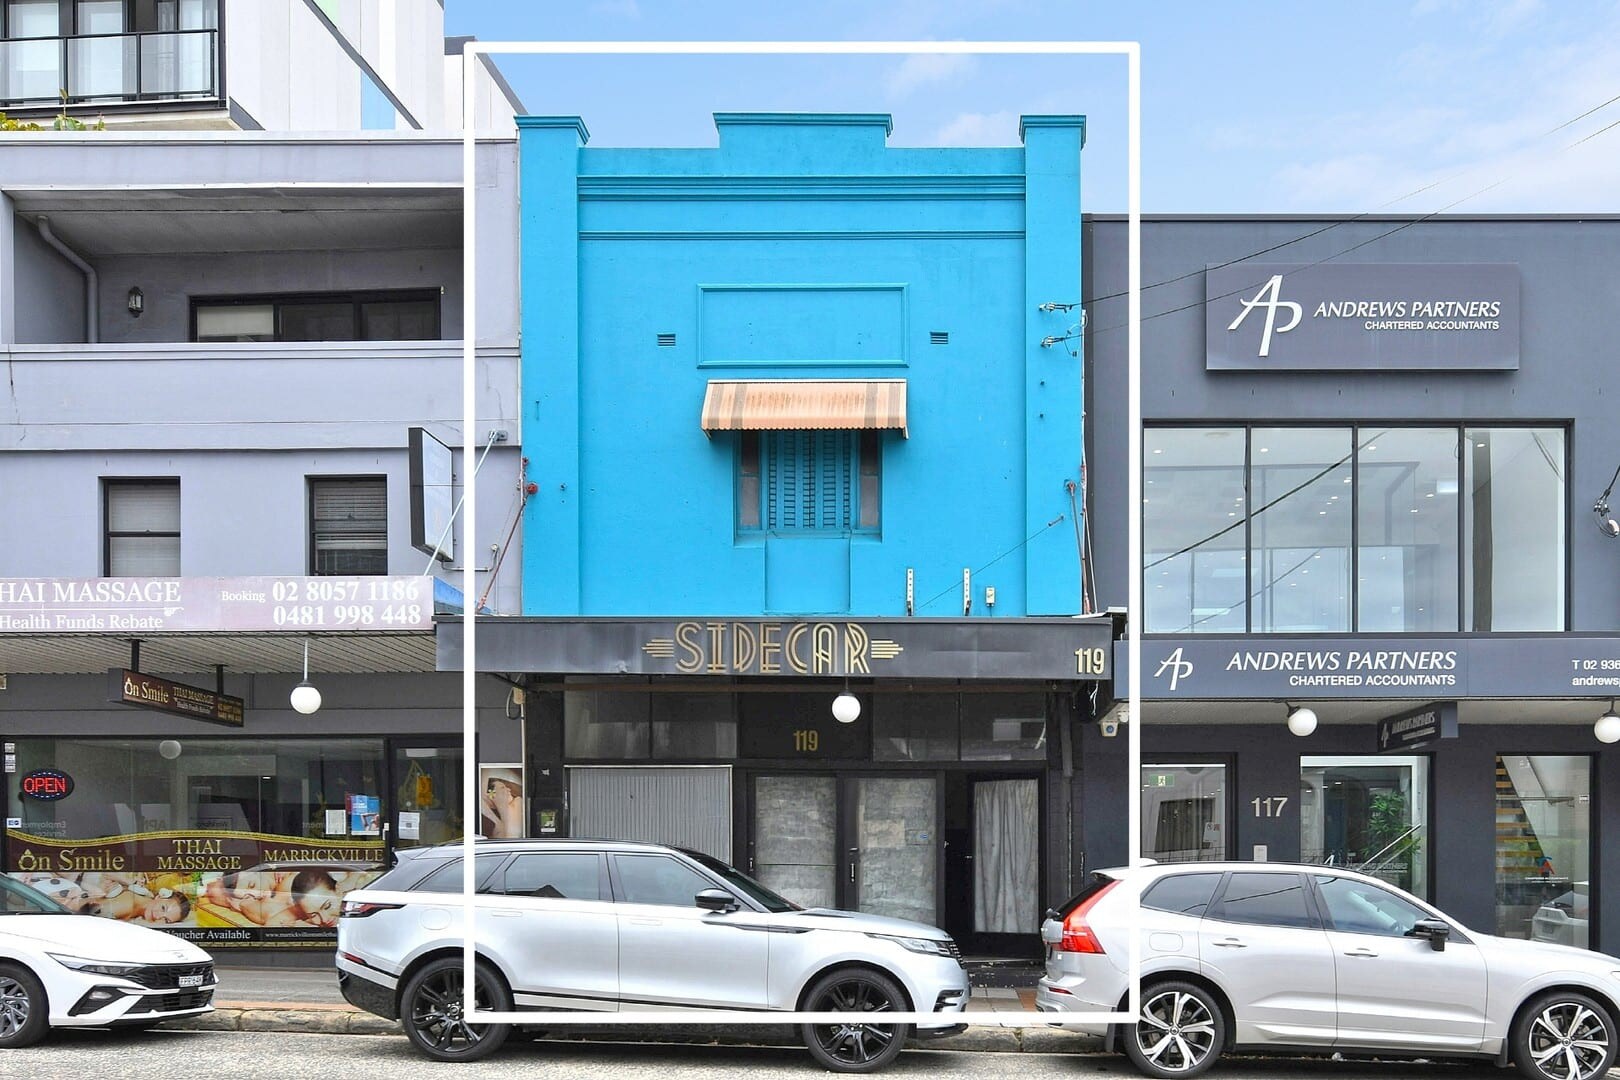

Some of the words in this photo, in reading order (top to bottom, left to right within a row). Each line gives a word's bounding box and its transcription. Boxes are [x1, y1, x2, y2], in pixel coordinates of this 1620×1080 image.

[1313, 301, 1407, 318] ANDREWS
[1410, 301, 1501, 318] PARTNERS
[1364, 320, 1424, 331] CHARTERED
[1426, 320, 1500, 331] ACCOUNTANTS
[53, 581, 181, 603] MASSAGE
[221, 590, 265, 604] Booking
[272, 581, 298, 601] 02
[306, 581, 360, 601] 8057
[368, 580, 419, 601] 1186
[0, 614, 49, 629] Health
[56, 614, 104, 629] Funds
[108, 614, 163, 629] Rebate
[273, 605, 325, 626] 0481
[334, 605, 374, 625] 998
[381, 604, 421, 625] 448
[675, 622, 871, 674] SIDECAR
[1074, 648, 1105, 675] 119
[1226, 651, 1341, 671] ANDREWS
[1346, 651, 1457, 670] PARTNERS
[1571, 659, 1580, 670] T
[1583, 659, 1598, 670] 02
[1289, 674, 1363, 686] CHARTERED
[1365, 674, 1456, 686] ACCOUNTANTS
[1572, 675, 1620, 687] andrews
[141, 681, 169, 704] Smile
[793, 730, 819, 752] 119
[23, 777, 66, 793] OPEN
[1251, 797, 1289, 818] 117
[172, 839, 222, 855] THAI
[264, 849, 384, 862] MARRICKVILLE
[58, 847, 125, 871] Smile
[158, 855, 242, 871] MASSAGE
[207, 929, 251, 940] Available
